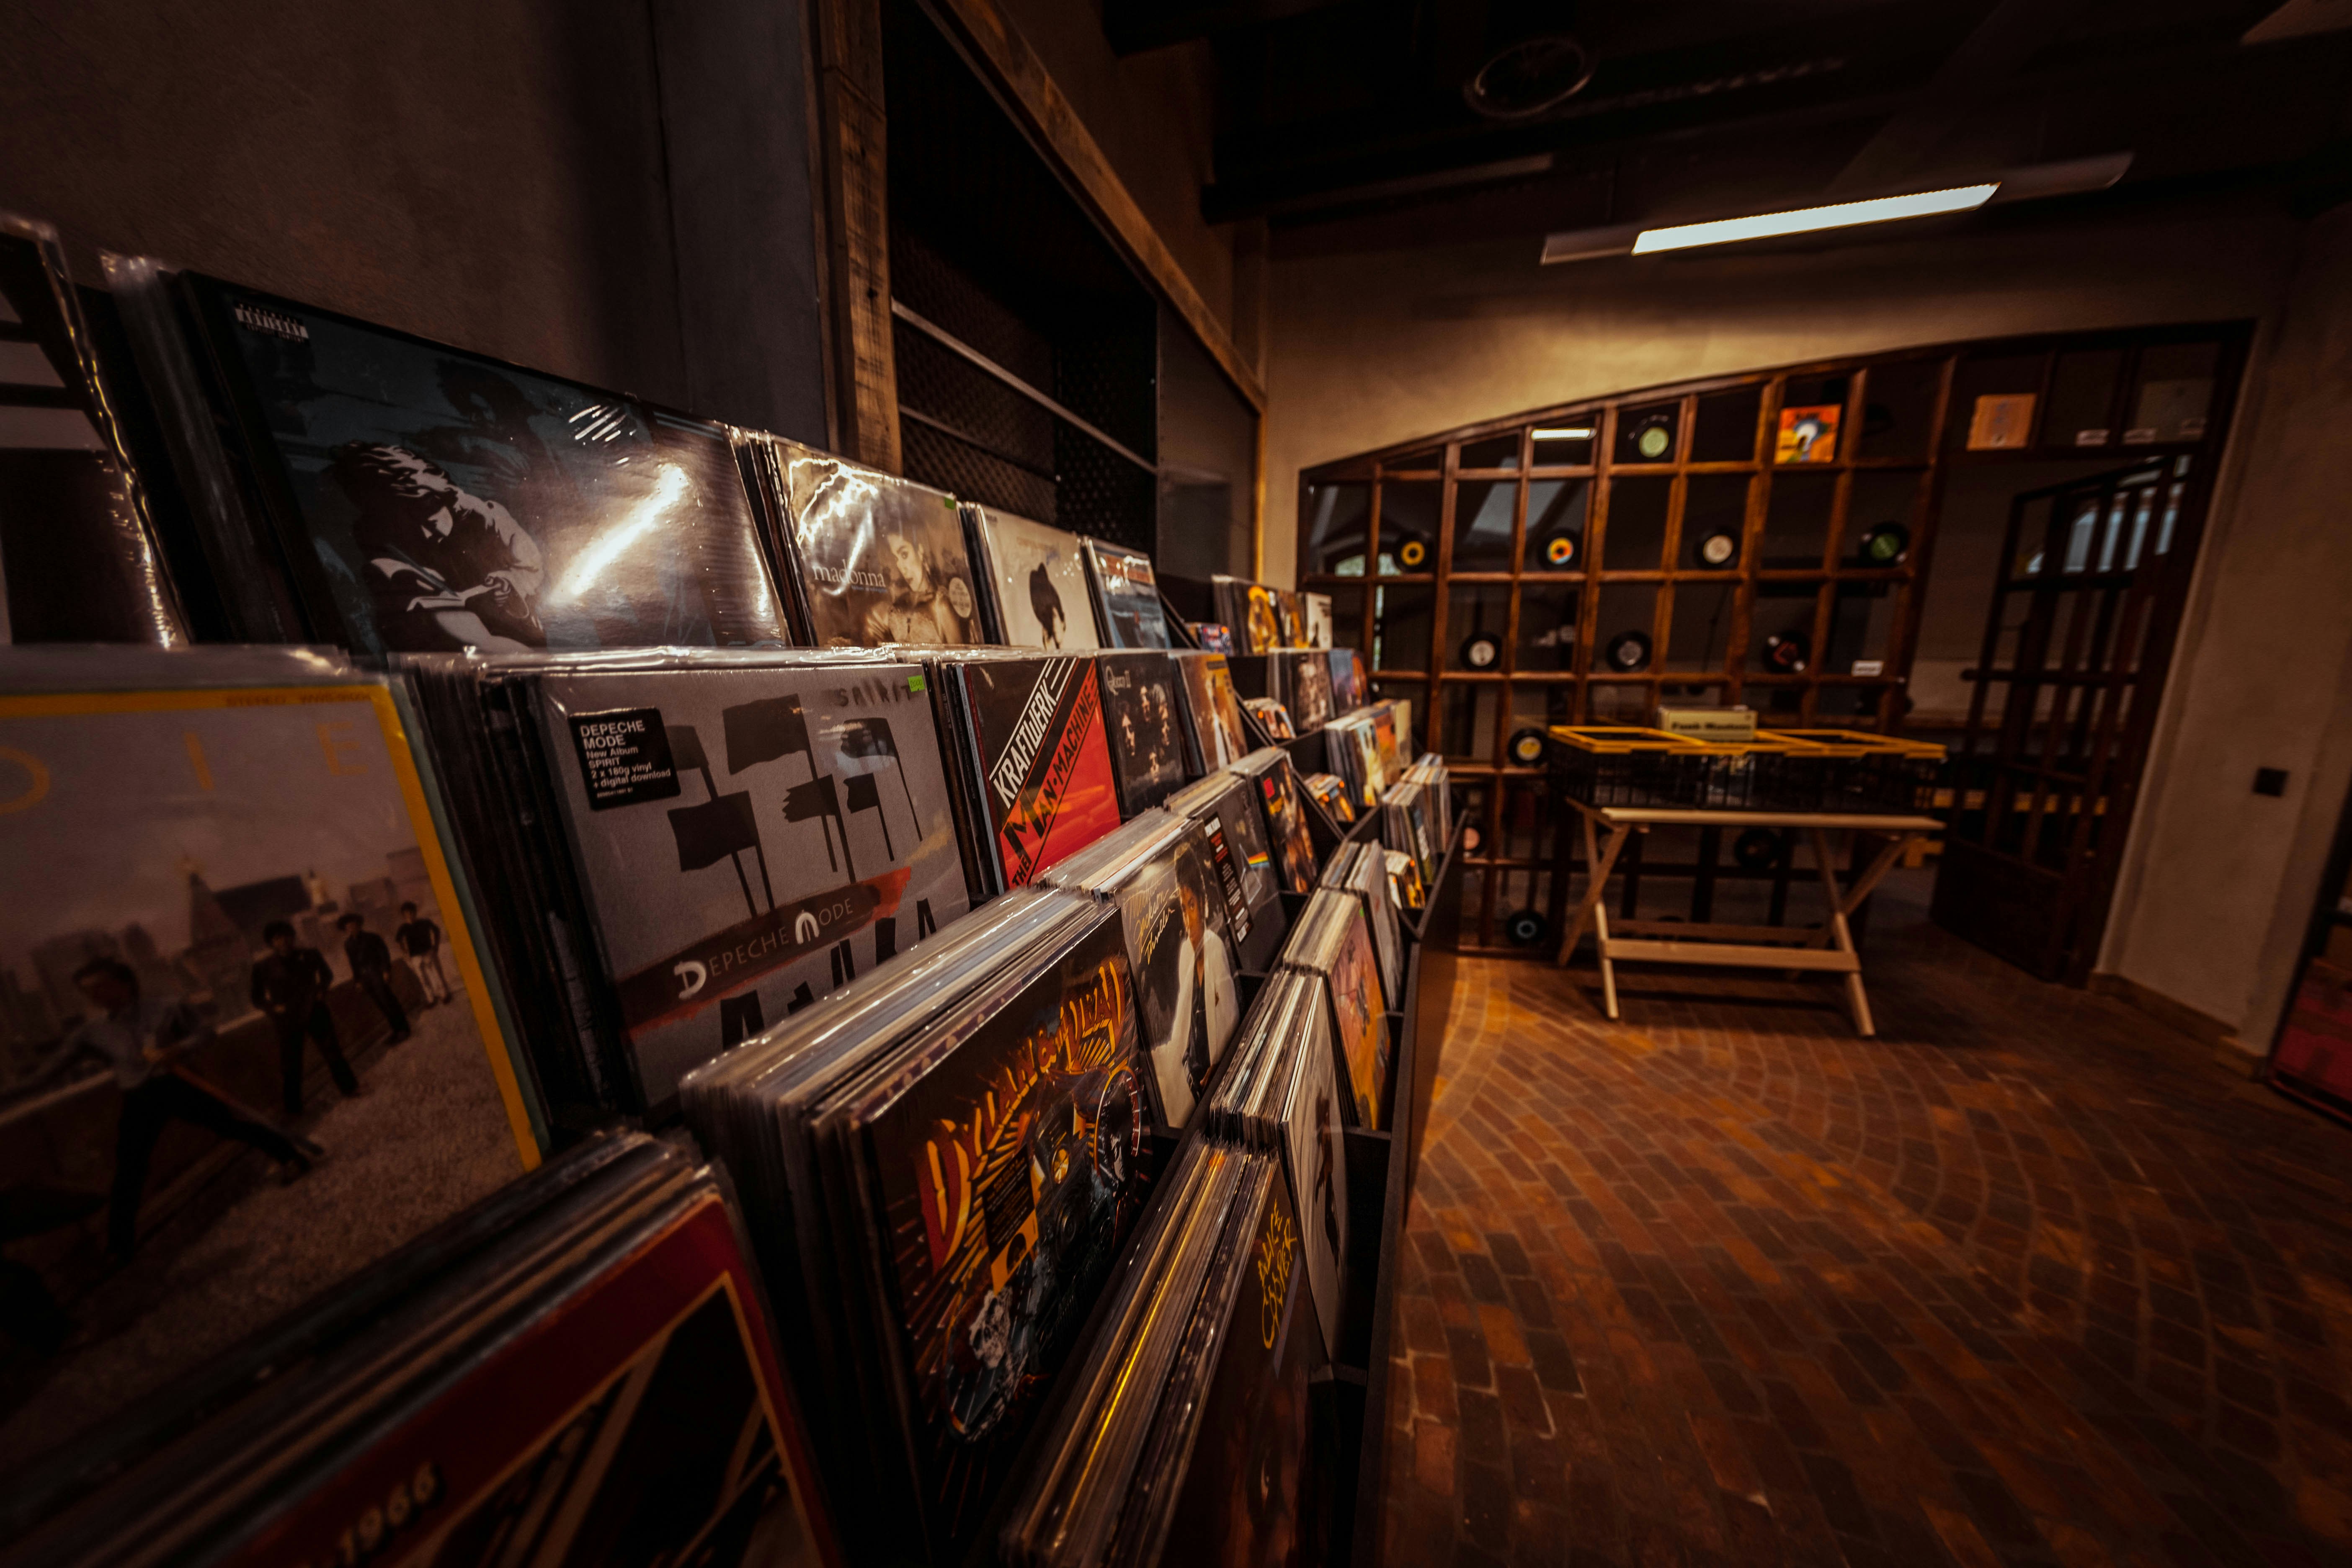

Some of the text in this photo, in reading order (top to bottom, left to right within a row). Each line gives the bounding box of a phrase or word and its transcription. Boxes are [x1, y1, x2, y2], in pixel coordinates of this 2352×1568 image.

[812, 559, 886, 587] madonna
[580, 720, 645, 737] DEPECHE
[583, 735, 626, 750] MODE
[993, 676, 1056, 810] KRAFTWERK
[587, 745, 639, 759] New Album
[588, 757, 620, 769] SPIRIT
[591, 770, 597, 779] 2
[608, 766, 629, 777] 180g
[632, 761, 652, 774] vinyl
[600, 774, 629, 788] digital
[631, 768, 671, 783] download
[673, 897, 854, 1000] DEPECHE MODE
